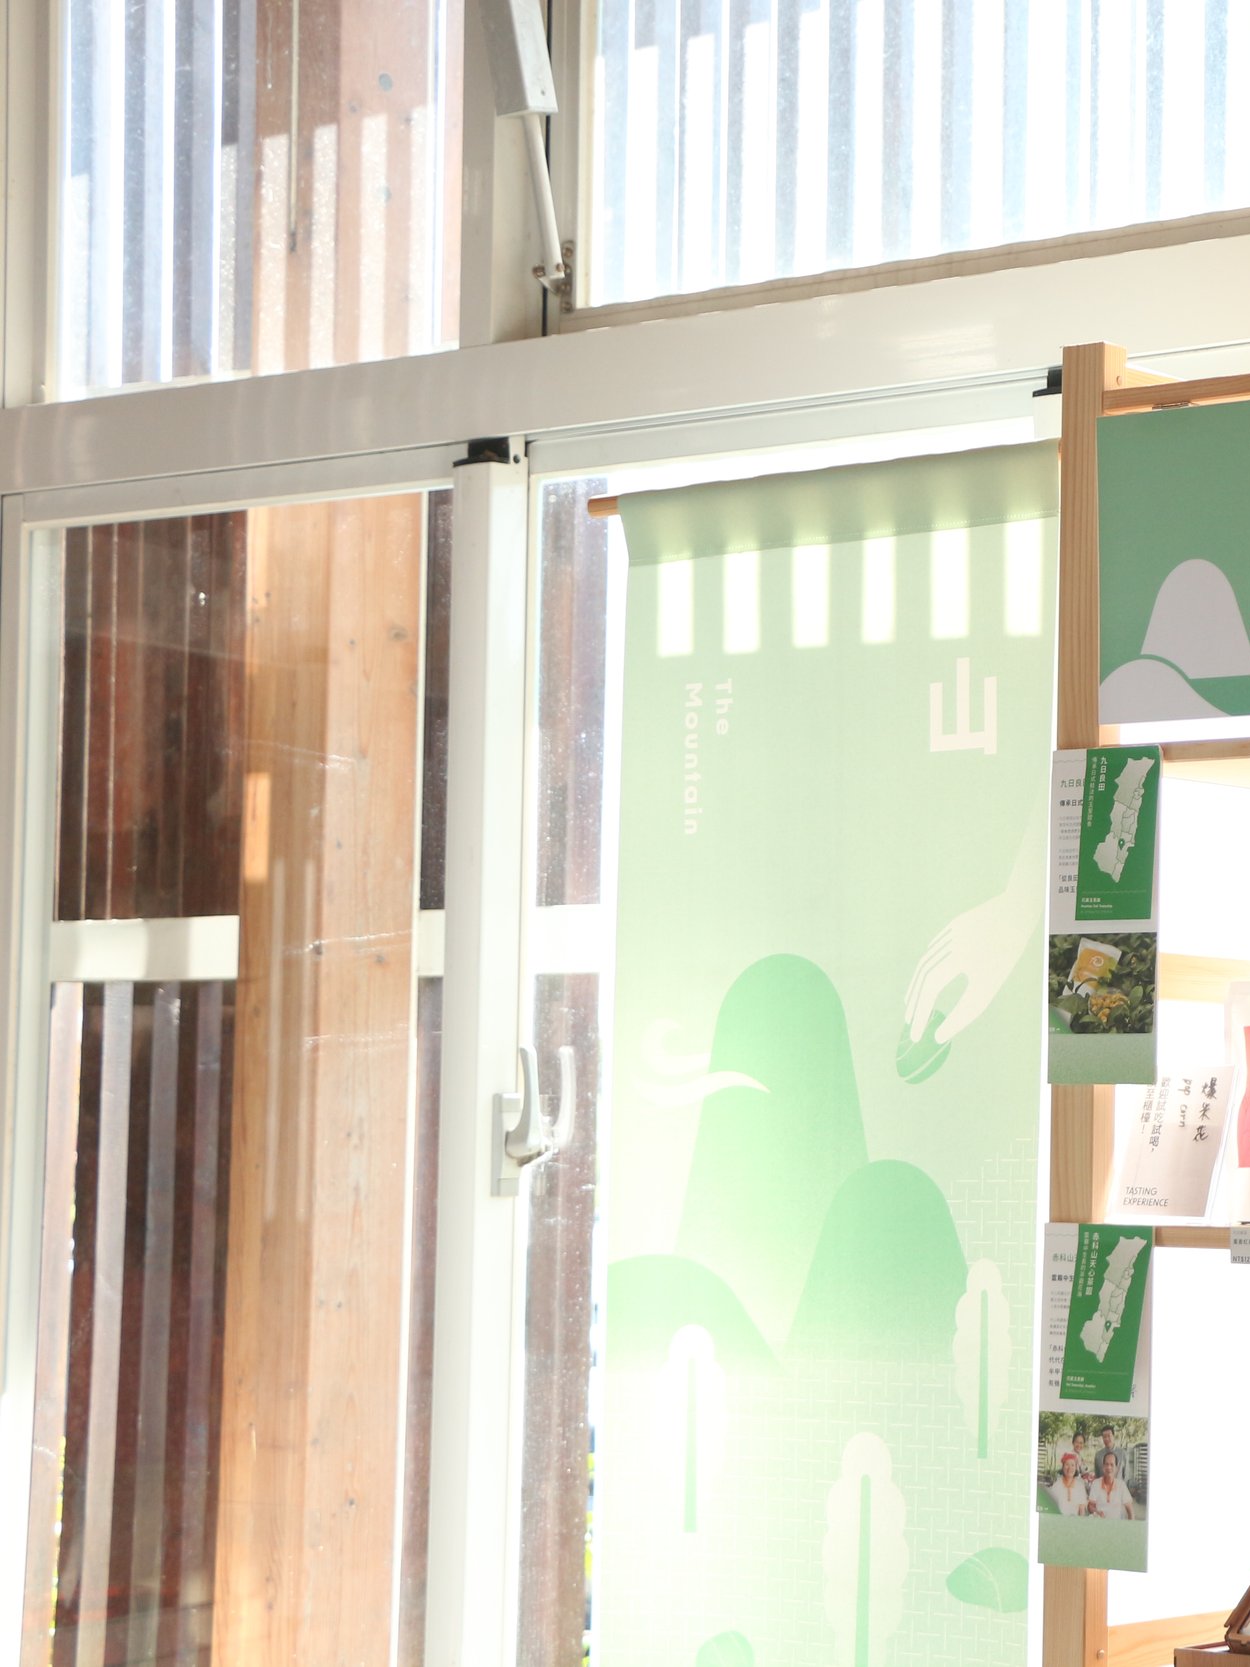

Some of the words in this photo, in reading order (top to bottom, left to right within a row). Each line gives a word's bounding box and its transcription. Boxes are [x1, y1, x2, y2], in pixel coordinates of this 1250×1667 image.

[716, 678, 733, 735] The
[930, 657, 997, 755] 山
[684, 682, 703, 835] Mountain
[1060, 779, 1085, 788] 九日良
[1123, 1197, 1169, 1207] EXPERIENCE
[1125, 1186, 1157, 1196] TASTING
